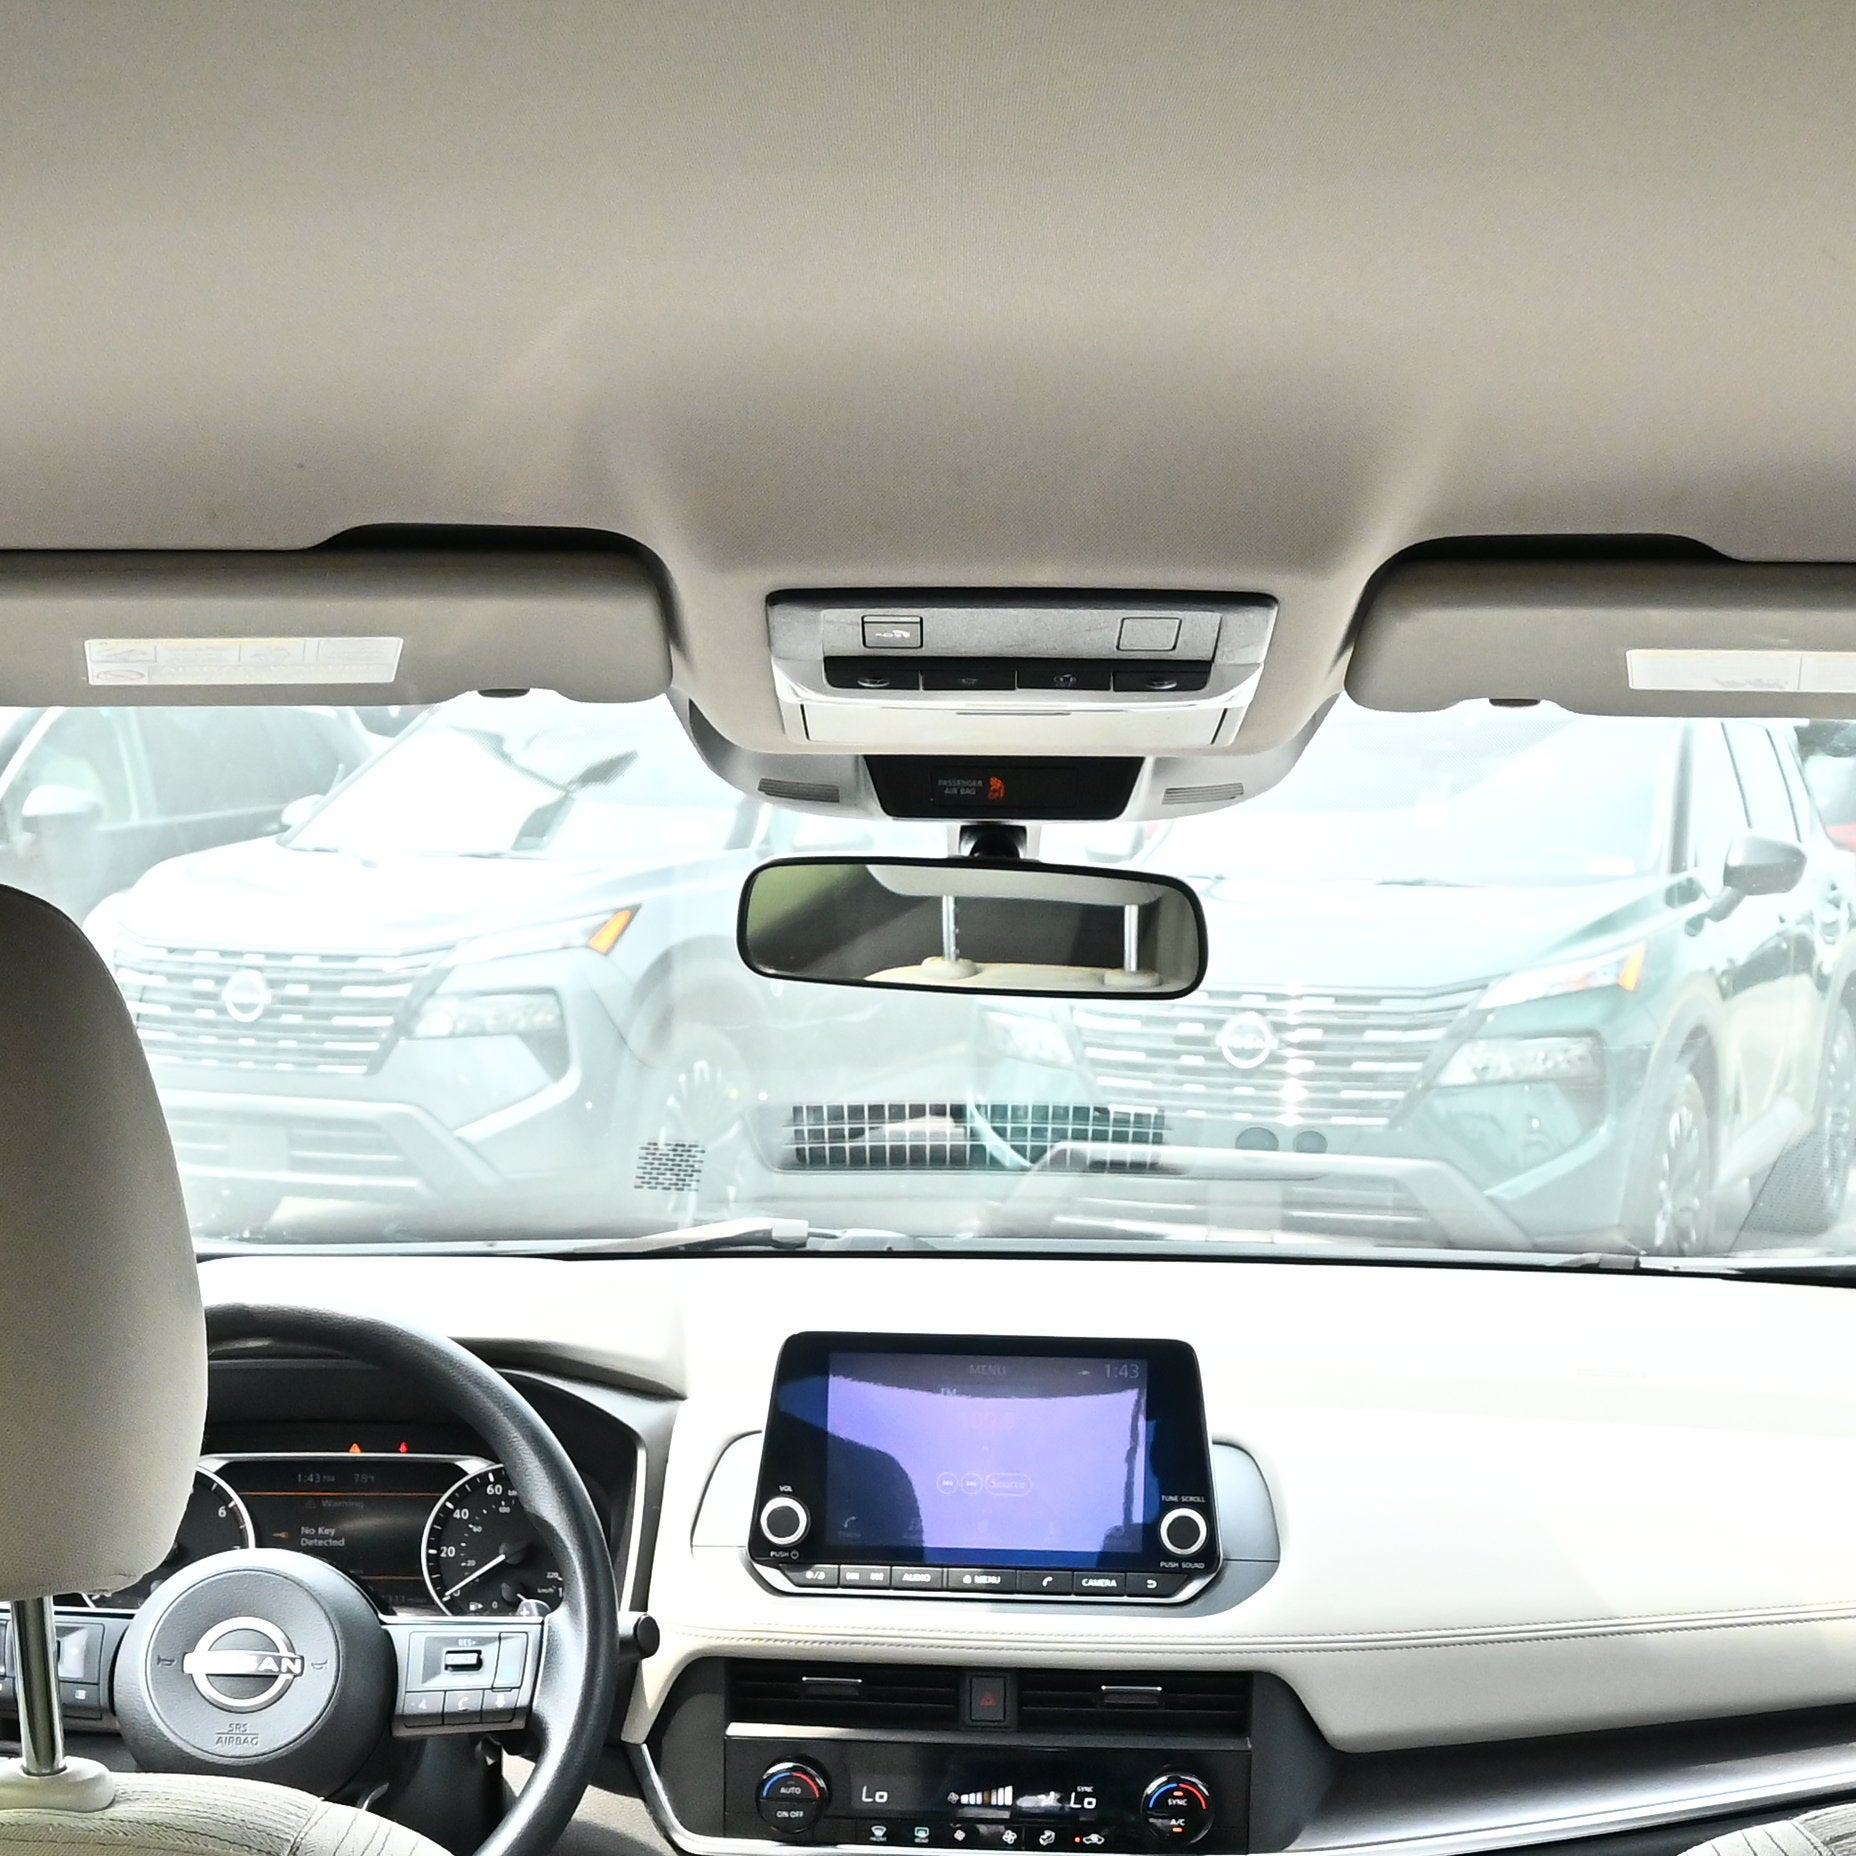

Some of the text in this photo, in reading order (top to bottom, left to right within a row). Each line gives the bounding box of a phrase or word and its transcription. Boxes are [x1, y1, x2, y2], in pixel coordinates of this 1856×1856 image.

[937, 779, 983, 787] PASSENGER
[1104, 1363, 1140, 1379] 1:43
[297, 1473, 321, 1483] 1:43
[990, 1477, 1026, 1488] Source
[486, 1484, 502, 1495] 60
[218, 1505, 227, 1518] 6
[453, 1508, 469, 1519] 40
[301, 1527, 336, 1537] No Key
[300, 1538, 345, 1547] Detected
[440, 1546, 456, 1557] 20
[1159, 1561, 1205, 1570] PUSH SOUND
[902, 1573, 931, 1582] AUDIO
[974, 1575, 1001, 1584] MENU
[1082, 1578, 1117, 1588] CAMERA
[228, 1723, 248, 1732] SRS
[215, 1736, 259, 1746] AIRBAG
[780, 1786, 801, 1795] AUTO
[861, 1785, 888, 1803] Lo
[1070, 1792, 1097, 1809] Lo
[1167, 1798, 1188, 1806] SYNC
[1170, 1818, 1186, 1826] A/C
